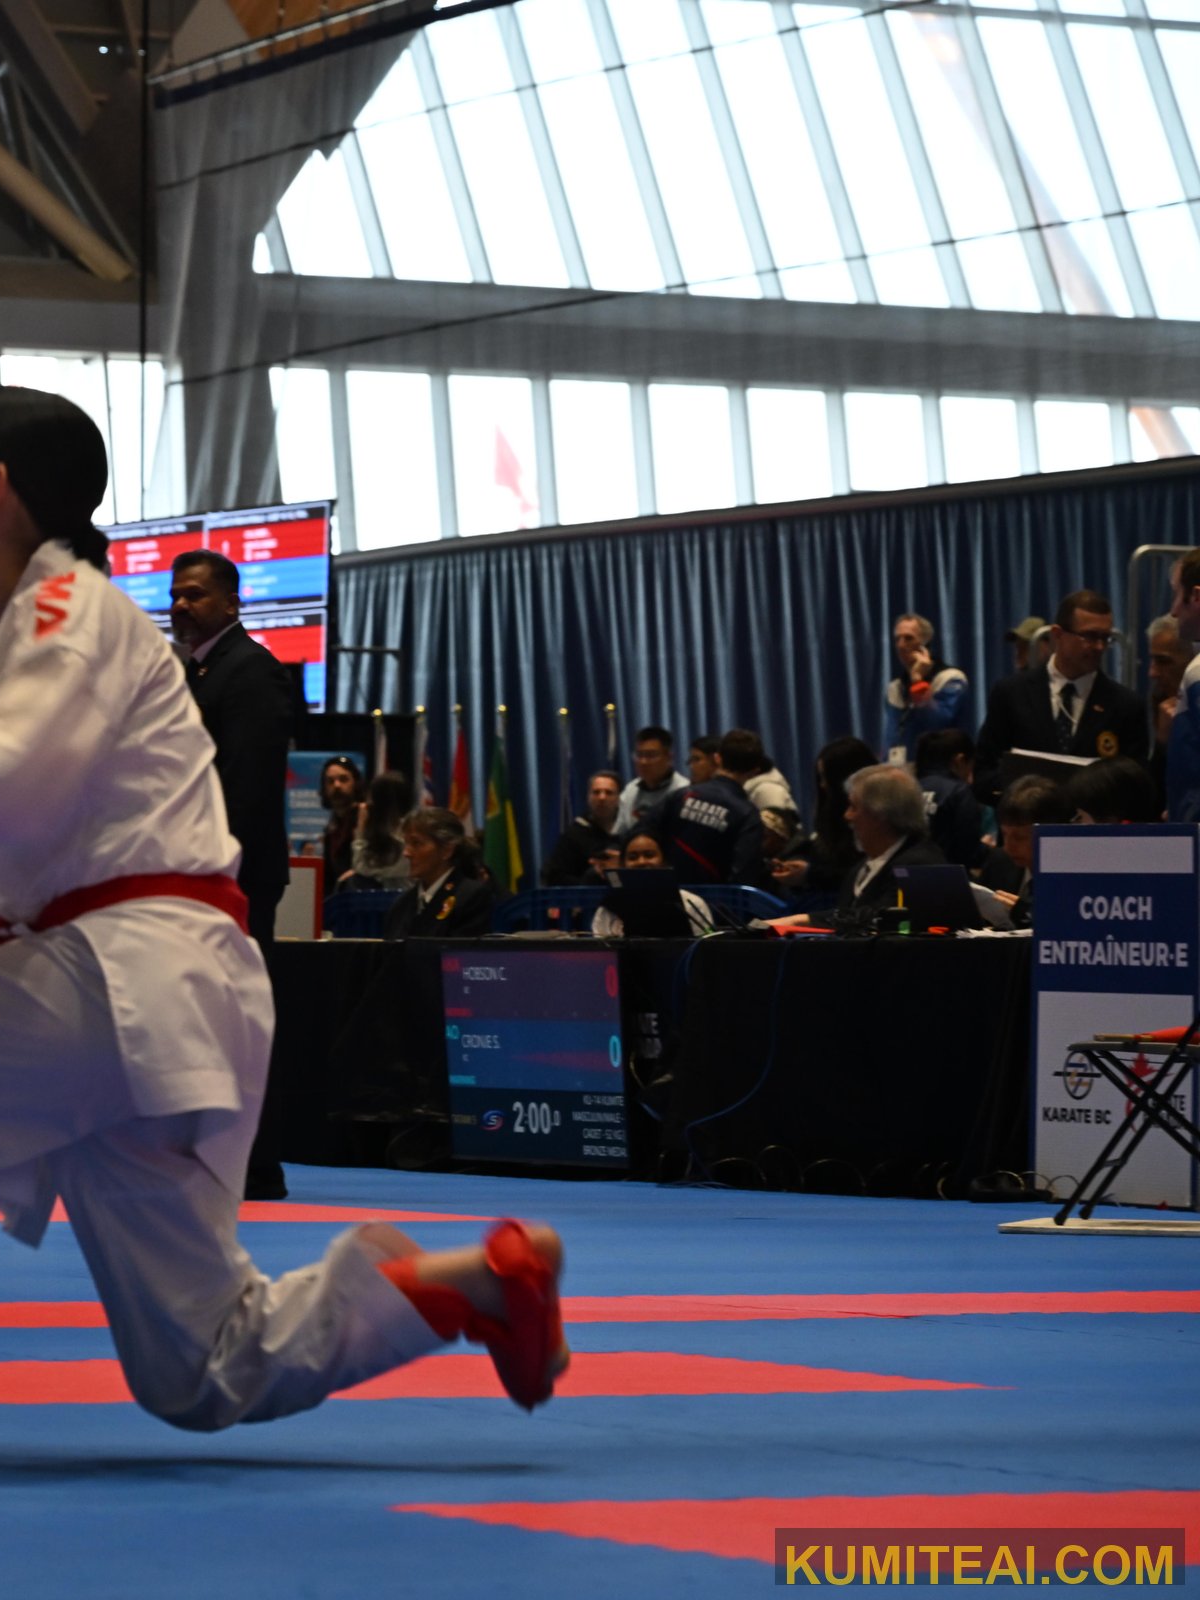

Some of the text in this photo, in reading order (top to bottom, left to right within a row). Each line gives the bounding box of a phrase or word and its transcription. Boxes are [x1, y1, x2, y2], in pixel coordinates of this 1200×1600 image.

[680, 807, 728, 831] ONTARIO
[684, 797, 729, 820] KARATE
[1079, 895, 1153, 921] COACH
[609, 1035, 621, 1068] 0
[1042, 1106, 1112, 1125] KARATE BC
